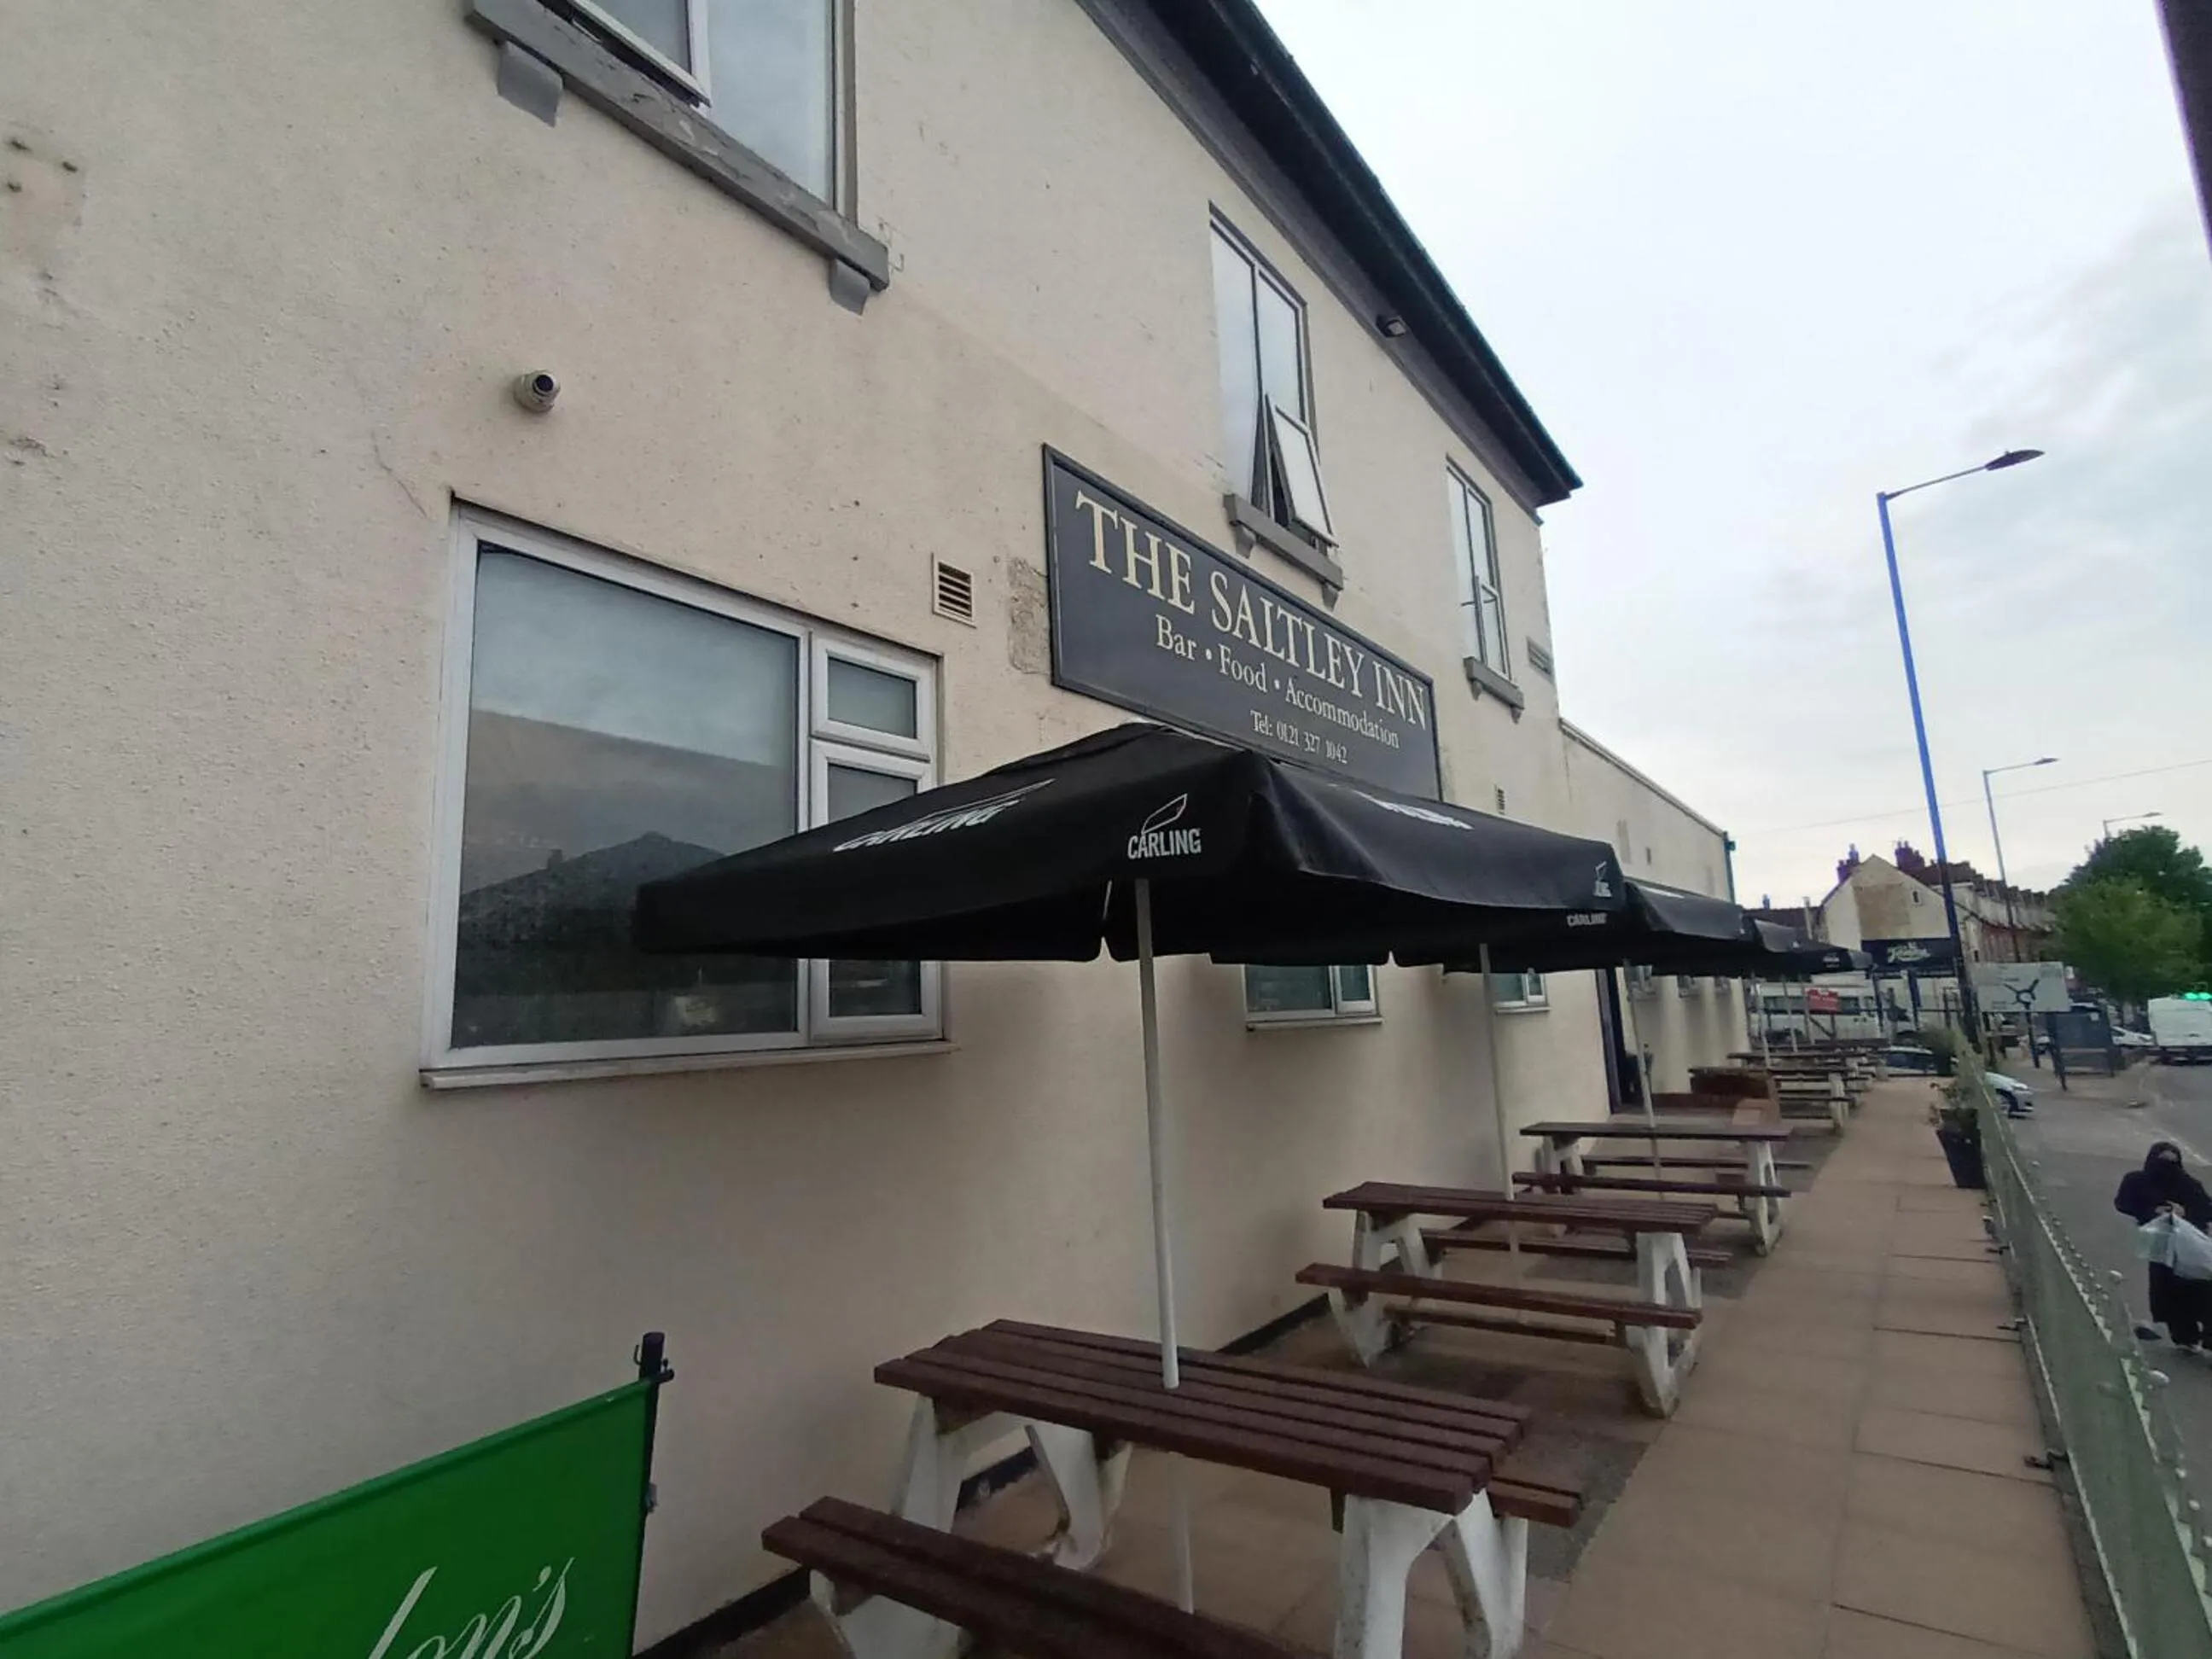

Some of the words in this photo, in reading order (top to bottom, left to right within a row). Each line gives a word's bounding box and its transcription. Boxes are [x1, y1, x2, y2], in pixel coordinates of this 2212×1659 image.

[1075, 489, 1196, 615] THE
[1209, 571, 1365, 698] SALTLEY
[1372, 661, 1426, 731] INN
[1155, 614, 1196, 661] Bar
[1218, 643, 1268, 694] Food
[1285, 677, 1400, 749] Accommodation
[1249, 709, 1273, 736] Tel:
[1276, 720, 1300, 747] 0121
[1303, 731, 1320, 754] 327
[1324, 740, 1348, 765] 1042
[1127, 828, 1202, 860] CARLING
